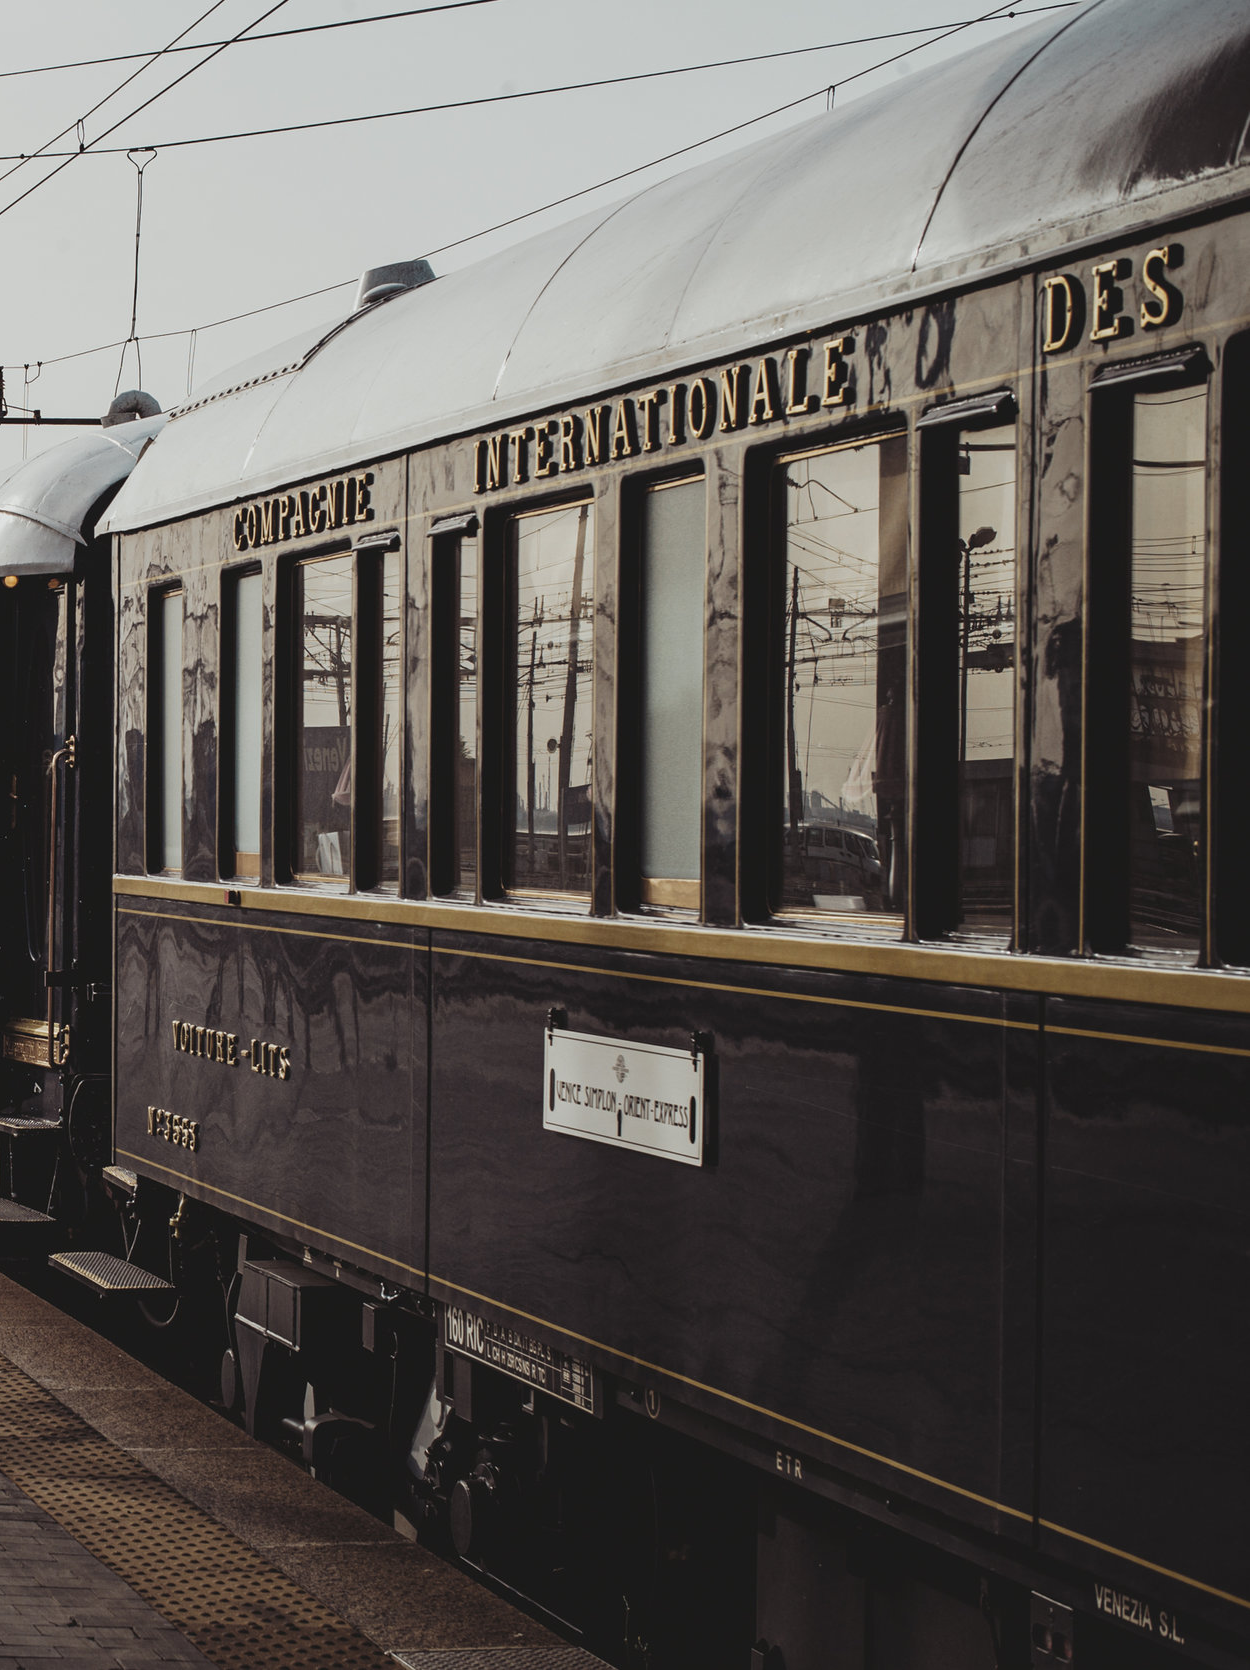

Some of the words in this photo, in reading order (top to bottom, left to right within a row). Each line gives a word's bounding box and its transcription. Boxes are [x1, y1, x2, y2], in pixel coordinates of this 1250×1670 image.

[233, 473, 372, 551] COMPAGNIE
[473, 338, 852, 494] INTERNATIONALE
[1042, 243, 1179, 354] DES
[172, 1020, 290, 1080] VOITURE-LITS
[556, 1080, 581, 1106] VENICE
[447, 1305, 464, 1345] 160
[466, 1313, 484, 1354] RIC
[1094, 1583, 1154, 1629] VENEZIA
[1158, 1611, 1186, 1645] S.L.
